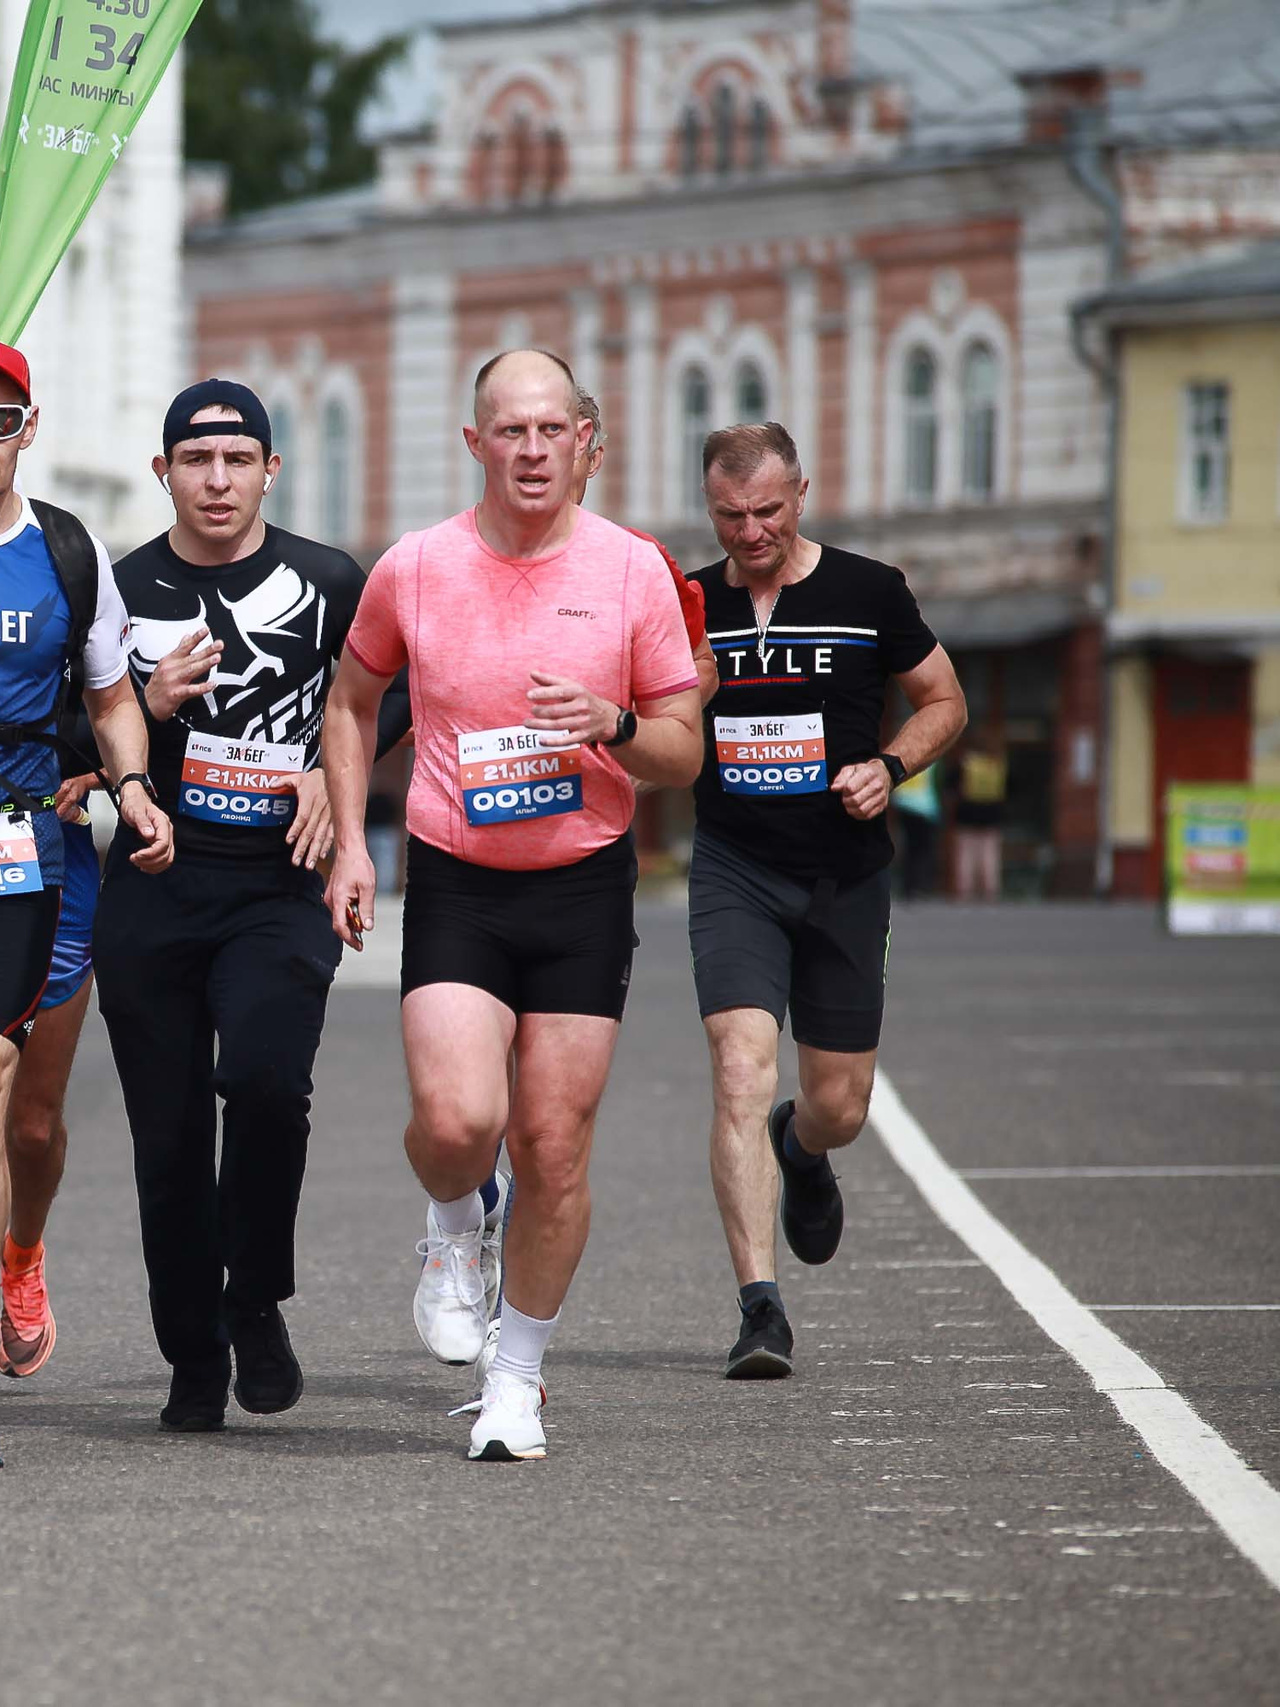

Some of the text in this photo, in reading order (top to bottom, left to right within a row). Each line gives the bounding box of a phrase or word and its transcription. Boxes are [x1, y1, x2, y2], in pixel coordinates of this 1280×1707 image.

[85, 24, 146, 74] 34
[557, 608, 590, 618] CRAFT
[714, 648, 832, 676] TYLE
[723, 765, 821, 783] 00067
[185, 788, 290, 815] 00045
[472, 782, 574, 811] 00103
